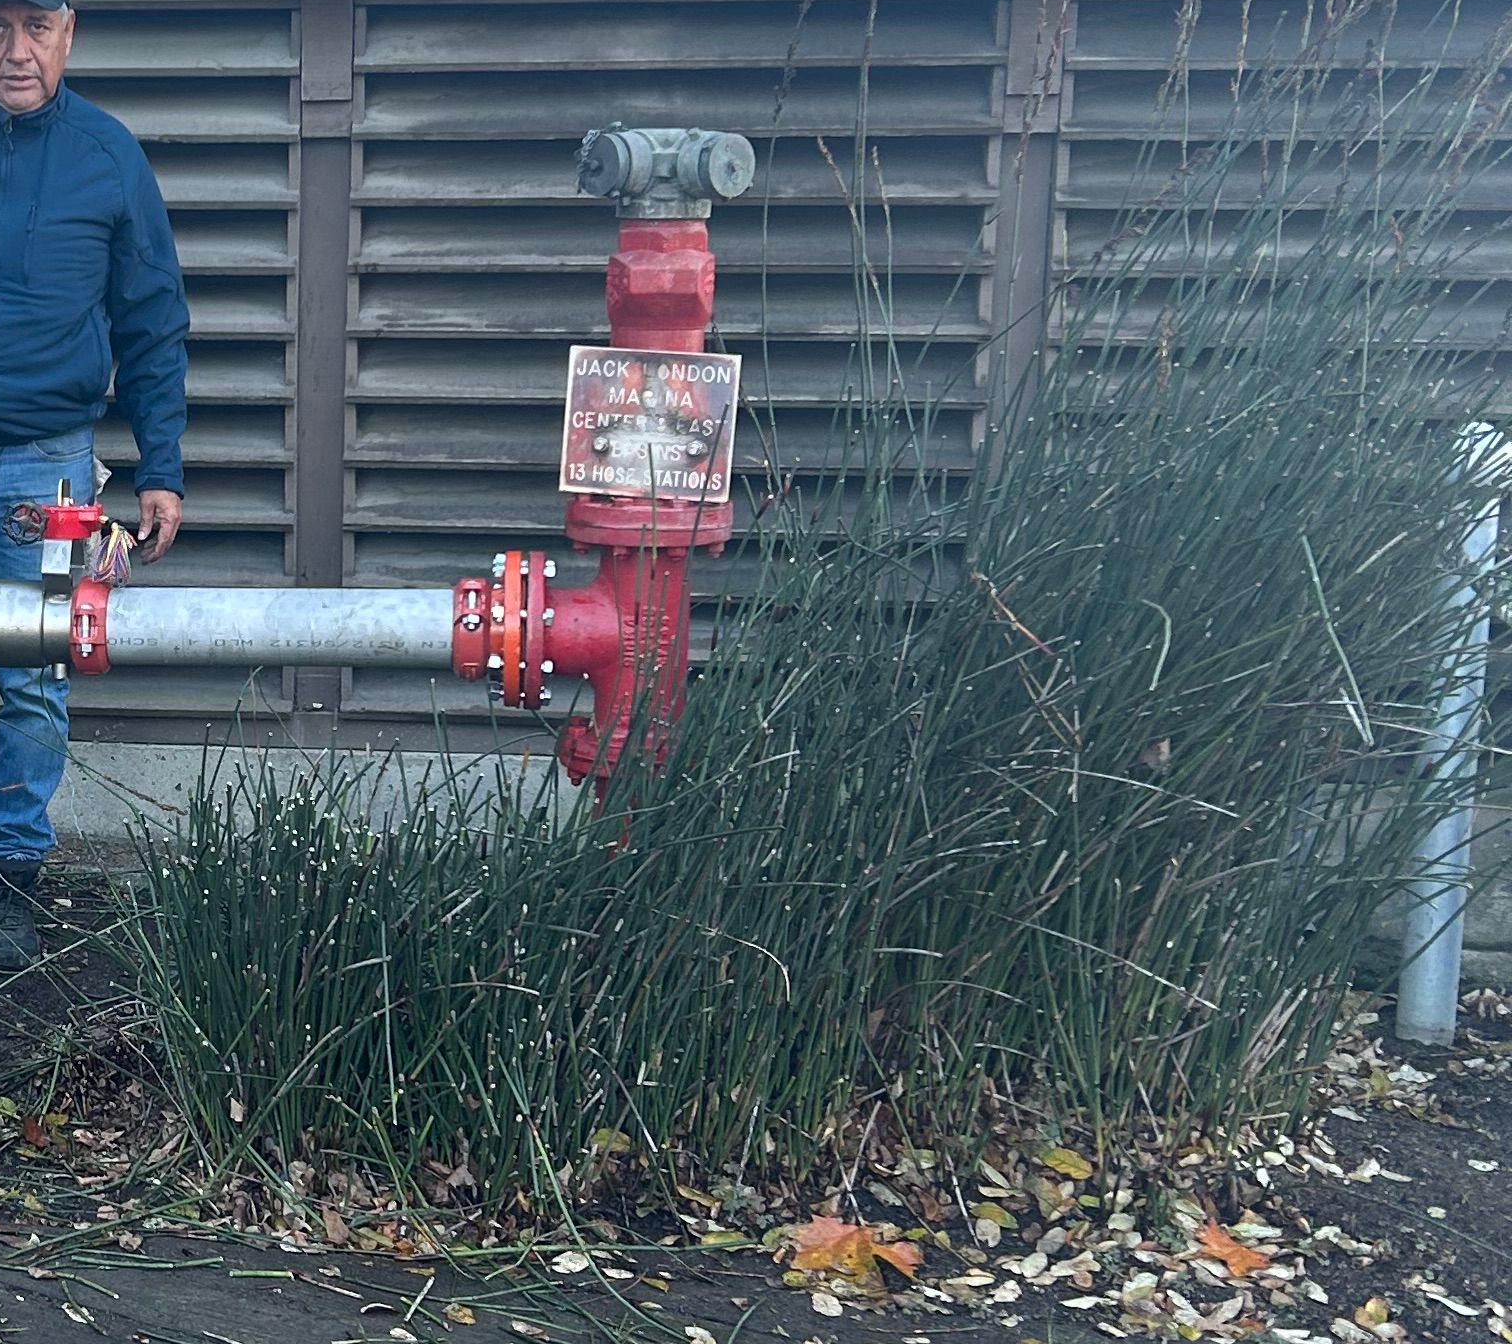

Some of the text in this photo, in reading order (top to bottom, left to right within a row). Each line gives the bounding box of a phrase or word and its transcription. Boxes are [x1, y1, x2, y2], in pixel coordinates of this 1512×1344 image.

[576, 359, 630, 377] JACK
[608, 387, 694, 409] MARNA
[610, 441, 683, 461] BSNS
[569, 463, 722, 491] 13 HOSE STATIONS
